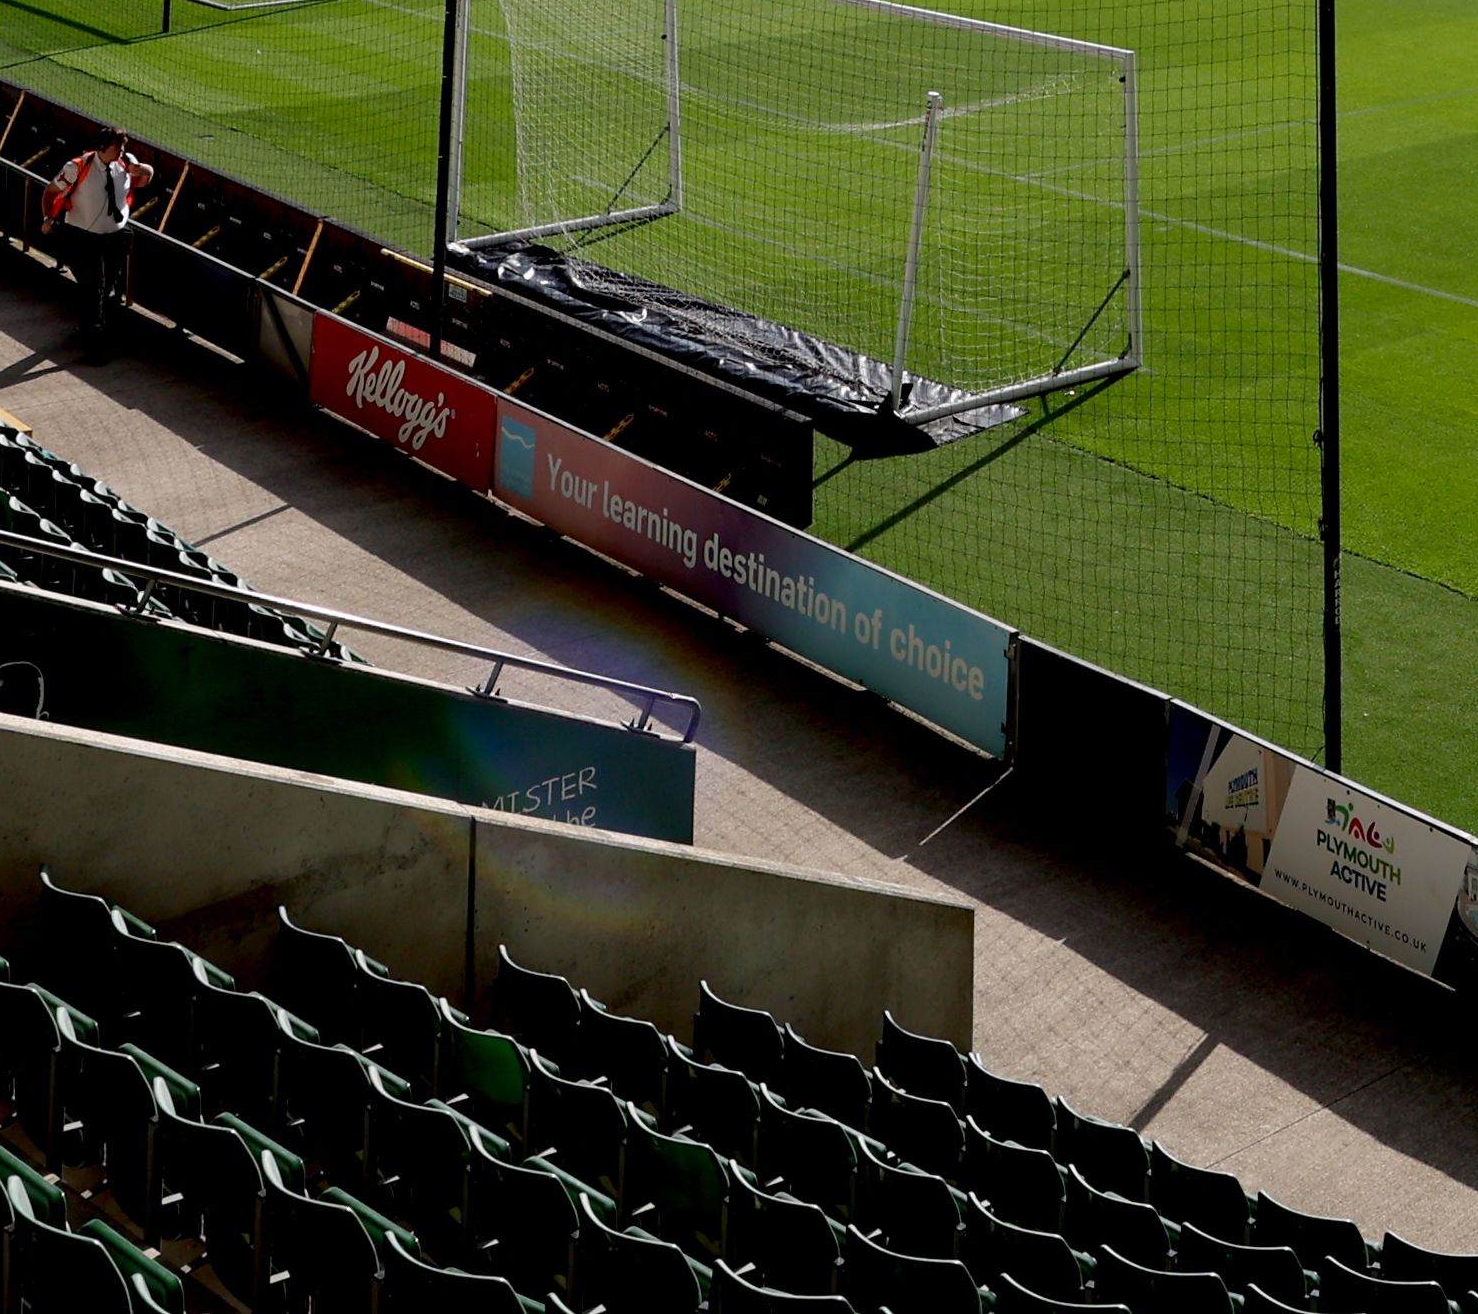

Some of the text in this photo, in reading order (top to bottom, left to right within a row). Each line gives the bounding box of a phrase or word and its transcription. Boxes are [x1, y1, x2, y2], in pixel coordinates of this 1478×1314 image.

[346, 345, 451, 451] Kellogg's
[545, 452, 984, 702] Your learning destination of choice
[1316, 829, 1401, 886] PLYMOUTH
[1330, 864, 1387, 902] ACTIVE
[1274, 868, 1428, 953] WWW.PLYMOUTHACTIVE.CO.UK
